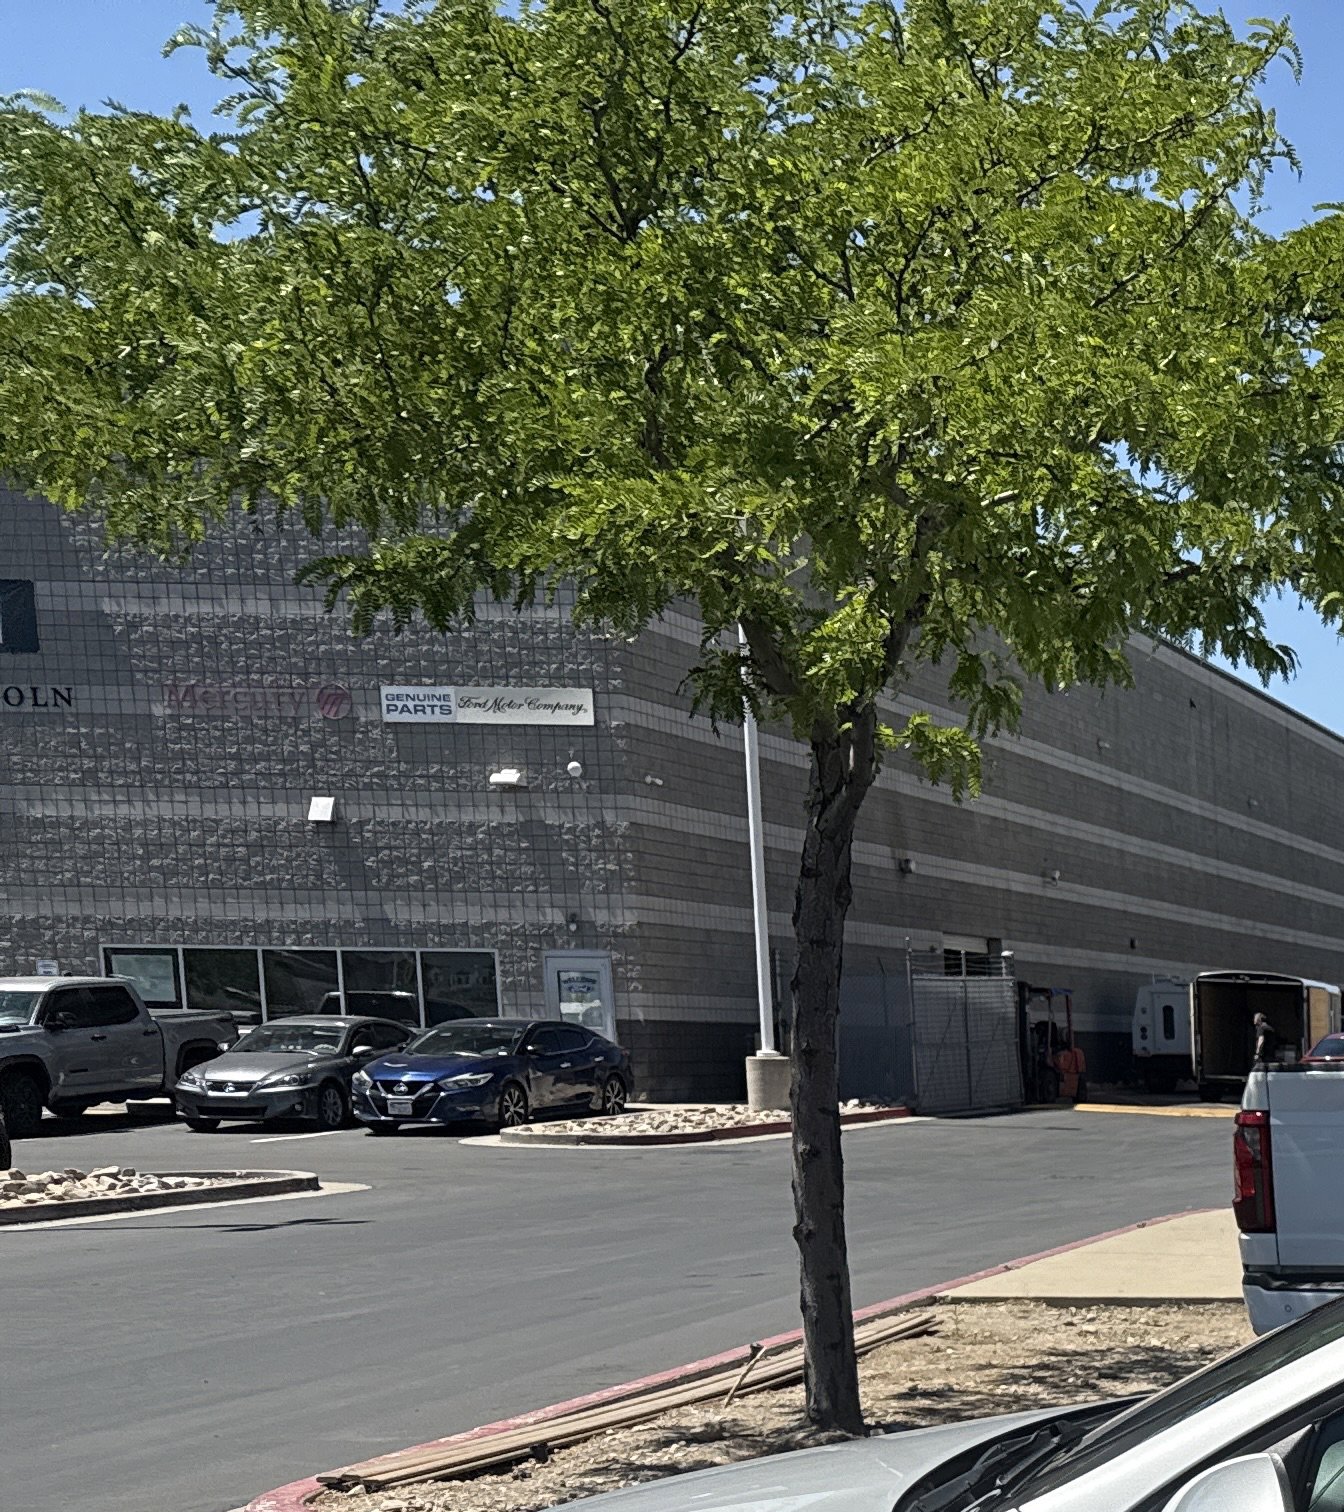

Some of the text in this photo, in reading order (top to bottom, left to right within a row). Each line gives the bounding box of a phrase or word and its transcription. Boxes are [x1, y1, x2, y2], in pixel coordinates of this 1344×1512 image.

[3, 685, 73, 707] OLN
[385, 693, 451, 702] GENUINE
[385, 704, 453, 715] PARTS
[457, 696, 585, 715] Ford Motor Company
